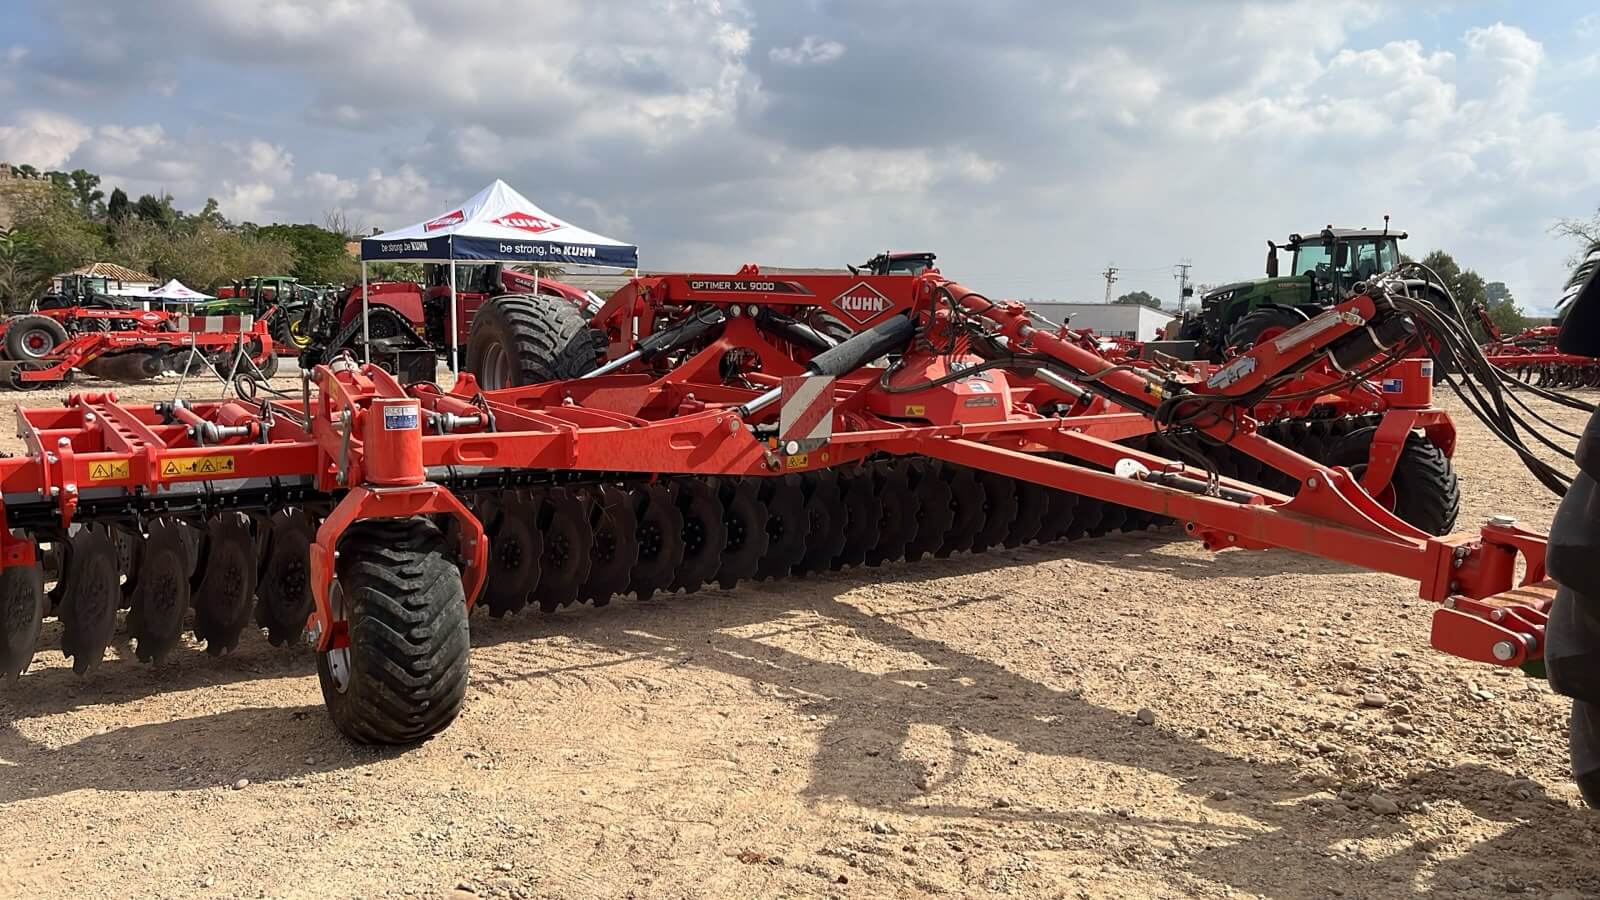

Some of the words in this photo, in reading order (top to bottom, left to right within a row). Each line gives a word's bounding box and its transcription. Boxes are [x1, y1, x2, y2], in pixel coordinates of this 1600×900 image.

[498, 217, 556, 229] KUHN
[499, 242, 513, 253] be
[514, 244, 548, 256] strong,
[549, 244, 562, 255] be
[563, 245, 596, 257] KUHN
[691, 281, 731, 290] OPTIMER
[734, 281, 747, 290] XL
[749, 282, 775, 291] 9000
[841, 296, 883, 312] KUHN
